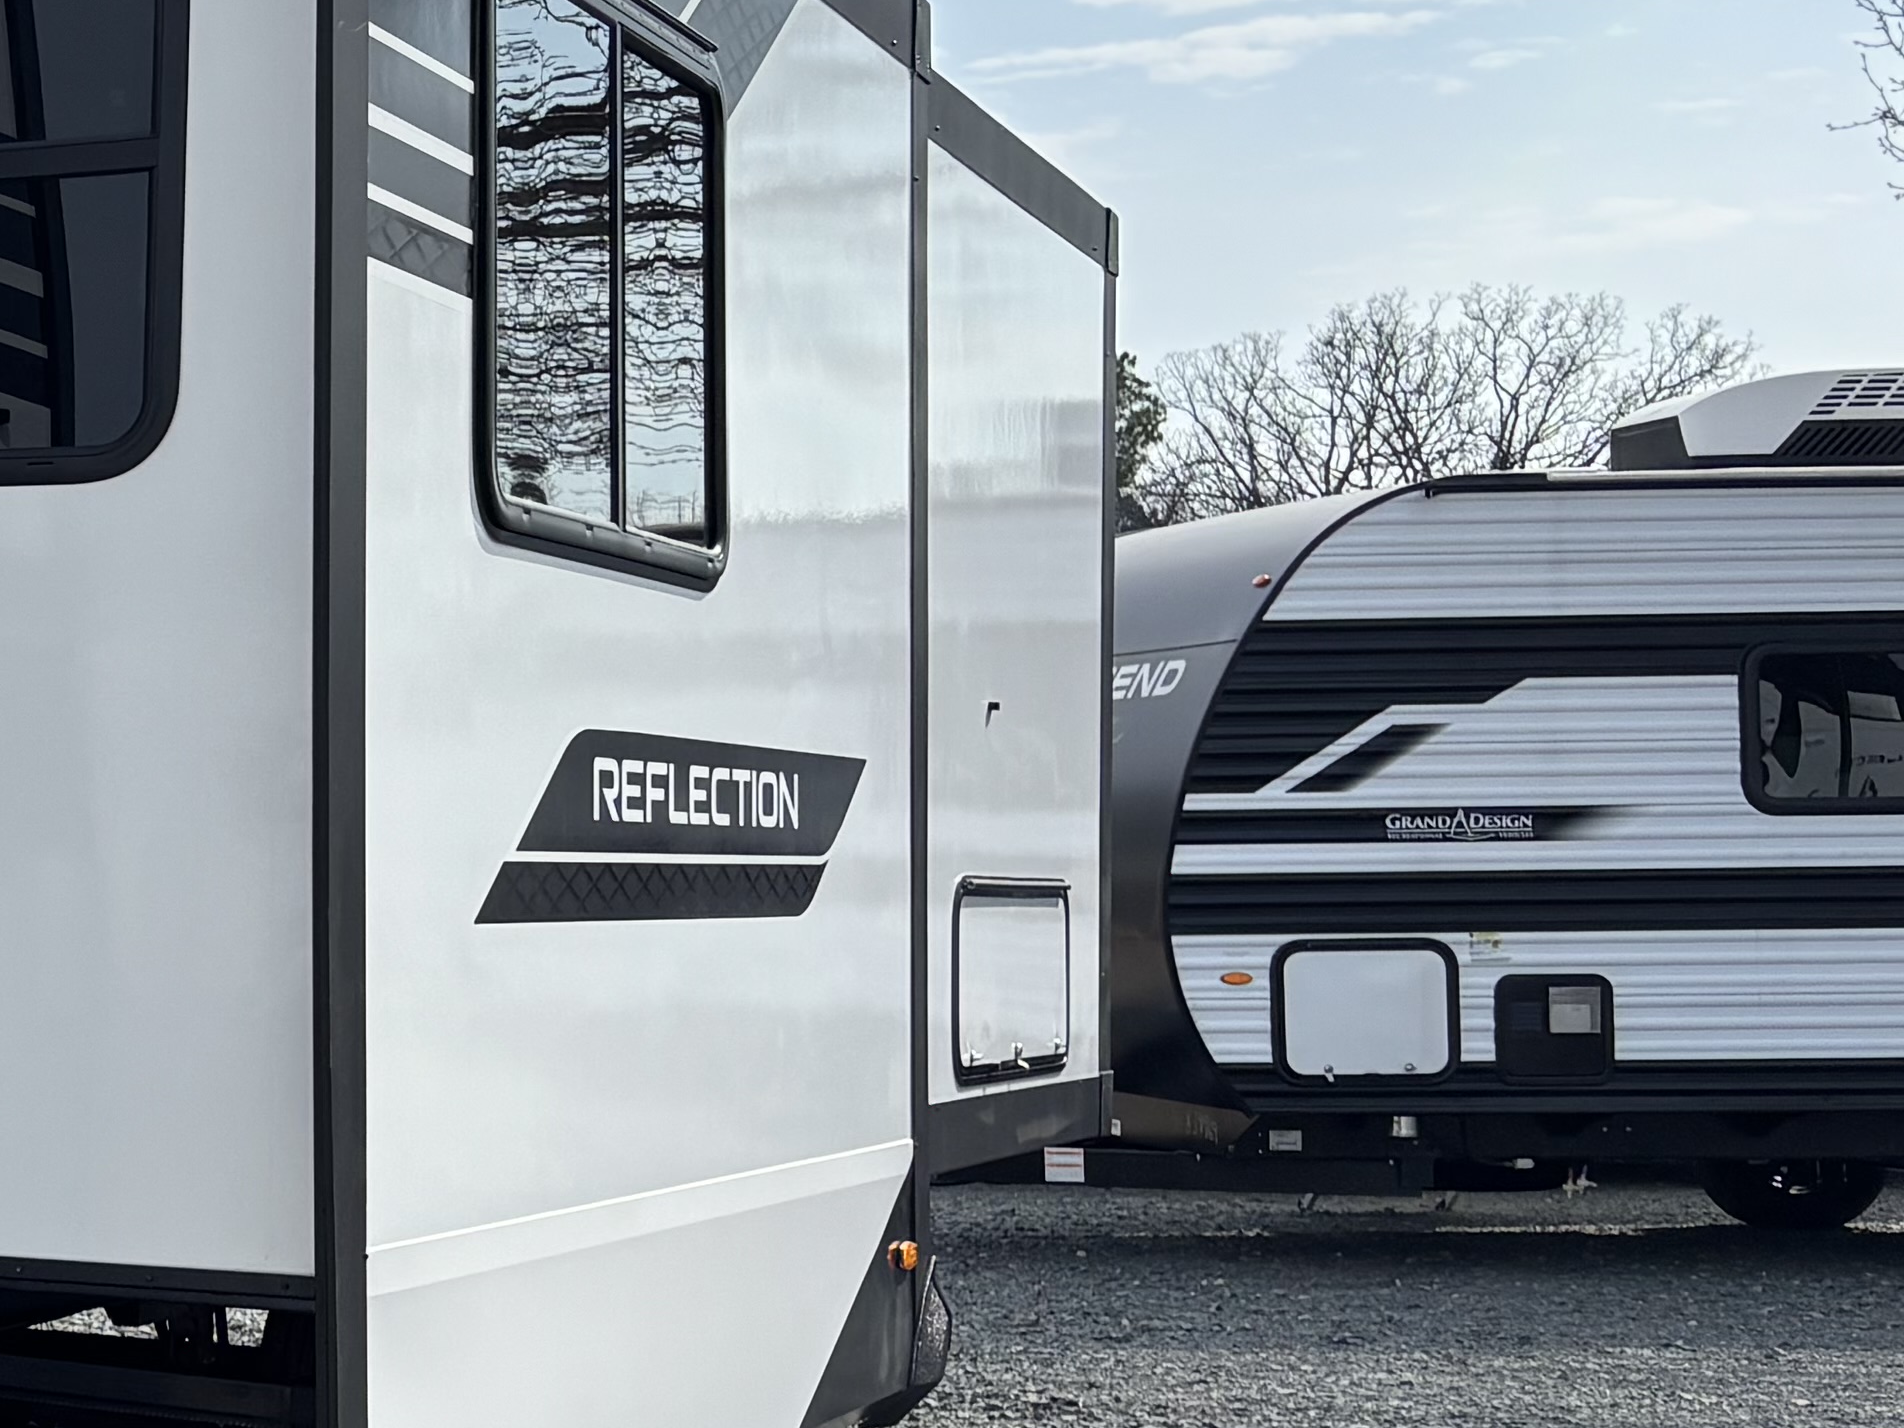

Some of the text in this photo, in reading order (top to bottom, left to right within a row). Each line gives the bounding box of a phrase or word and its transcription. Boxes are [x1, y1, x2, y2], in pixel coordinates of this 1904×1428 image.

[1112, 659, 1187, 700] END
[593, 756, 799, 830] REFLECTION
[1385, 813, 1534, 830] GRAND DESIGN
